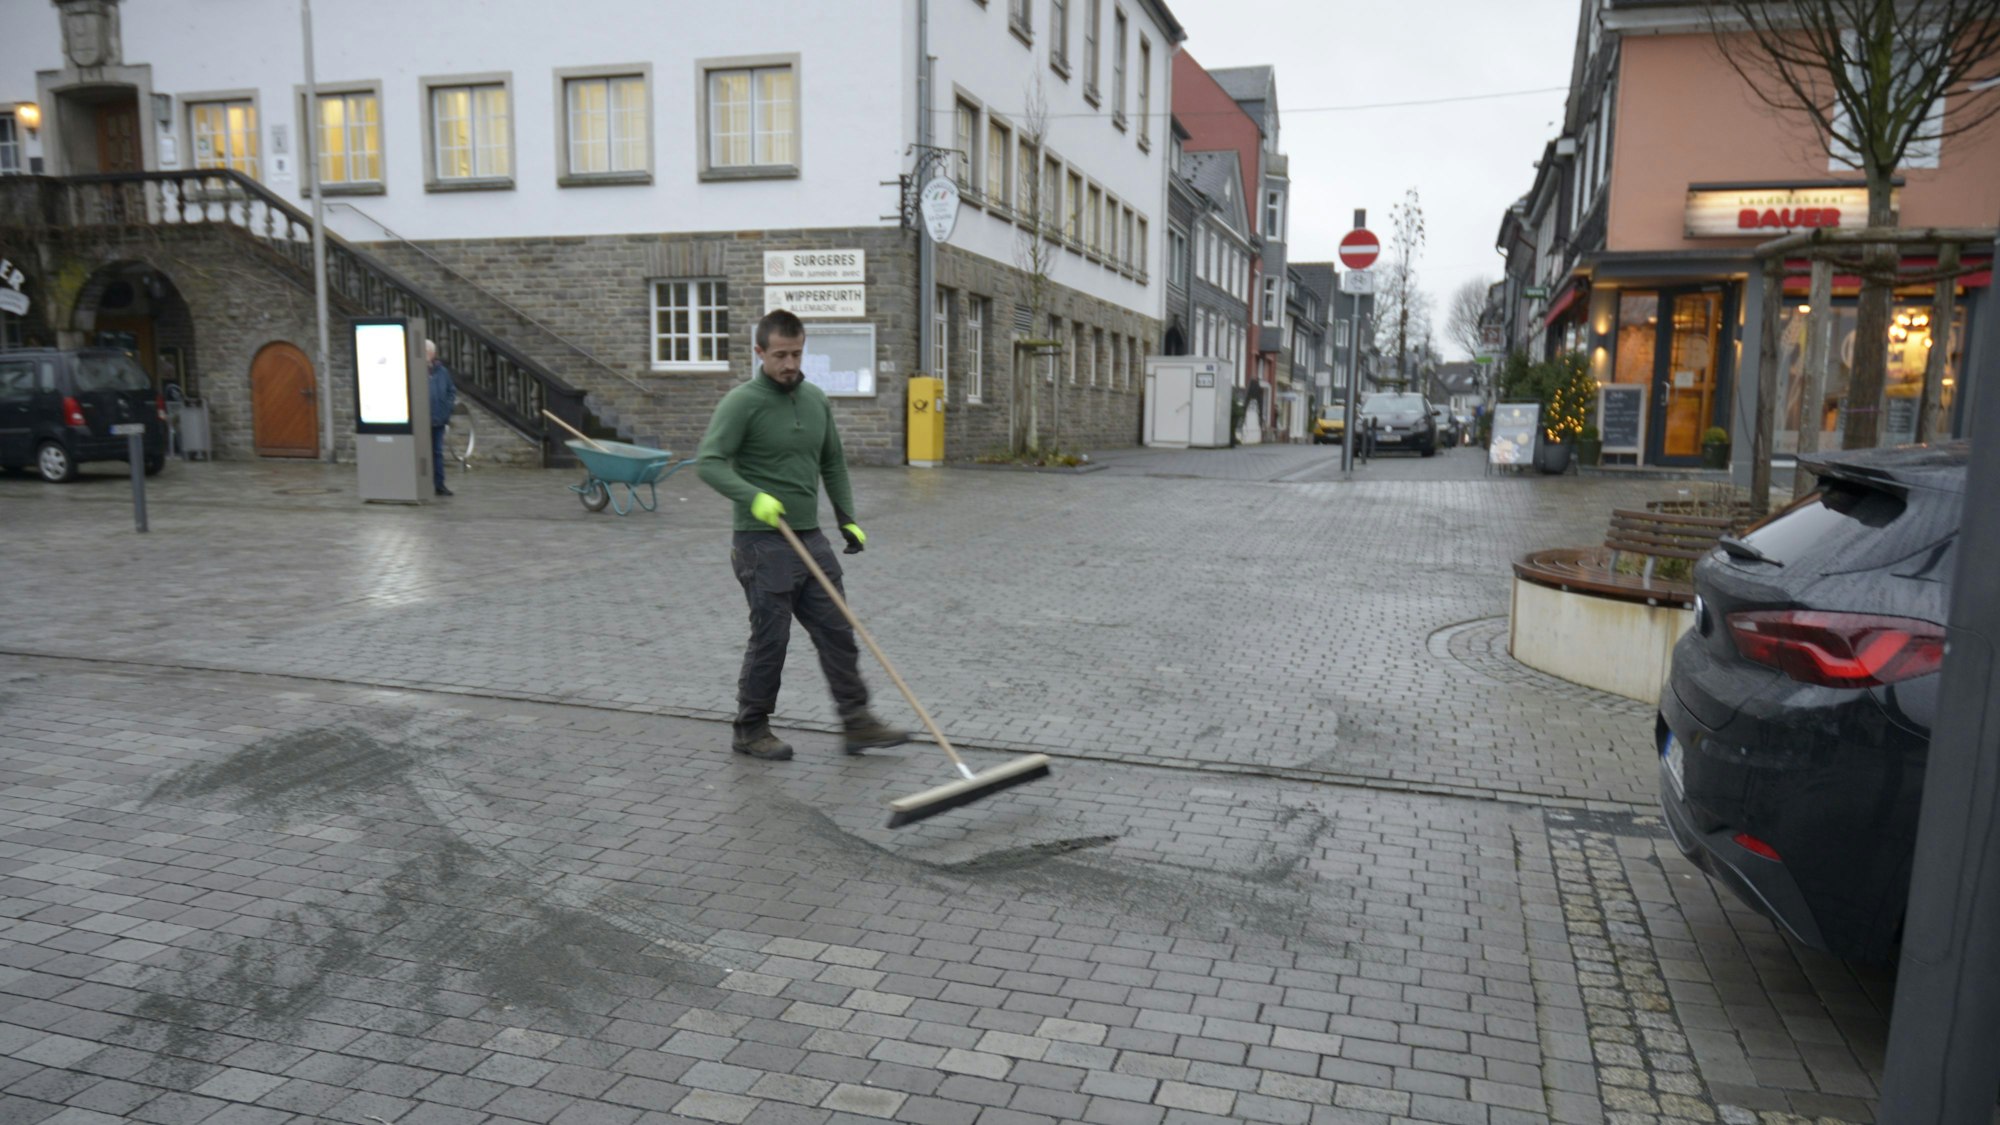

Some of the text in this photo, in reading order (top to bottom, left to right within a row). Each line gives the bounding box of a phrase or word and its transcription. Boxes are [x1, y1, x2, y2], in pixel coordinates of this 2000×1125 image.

[1738, 208, 1841, 228] BAUER
[793, 254, 856, 266] SURGERES
[788, 269, 804, 277] Ville
[790, 303, 837, 312] ALLEMAGNE
